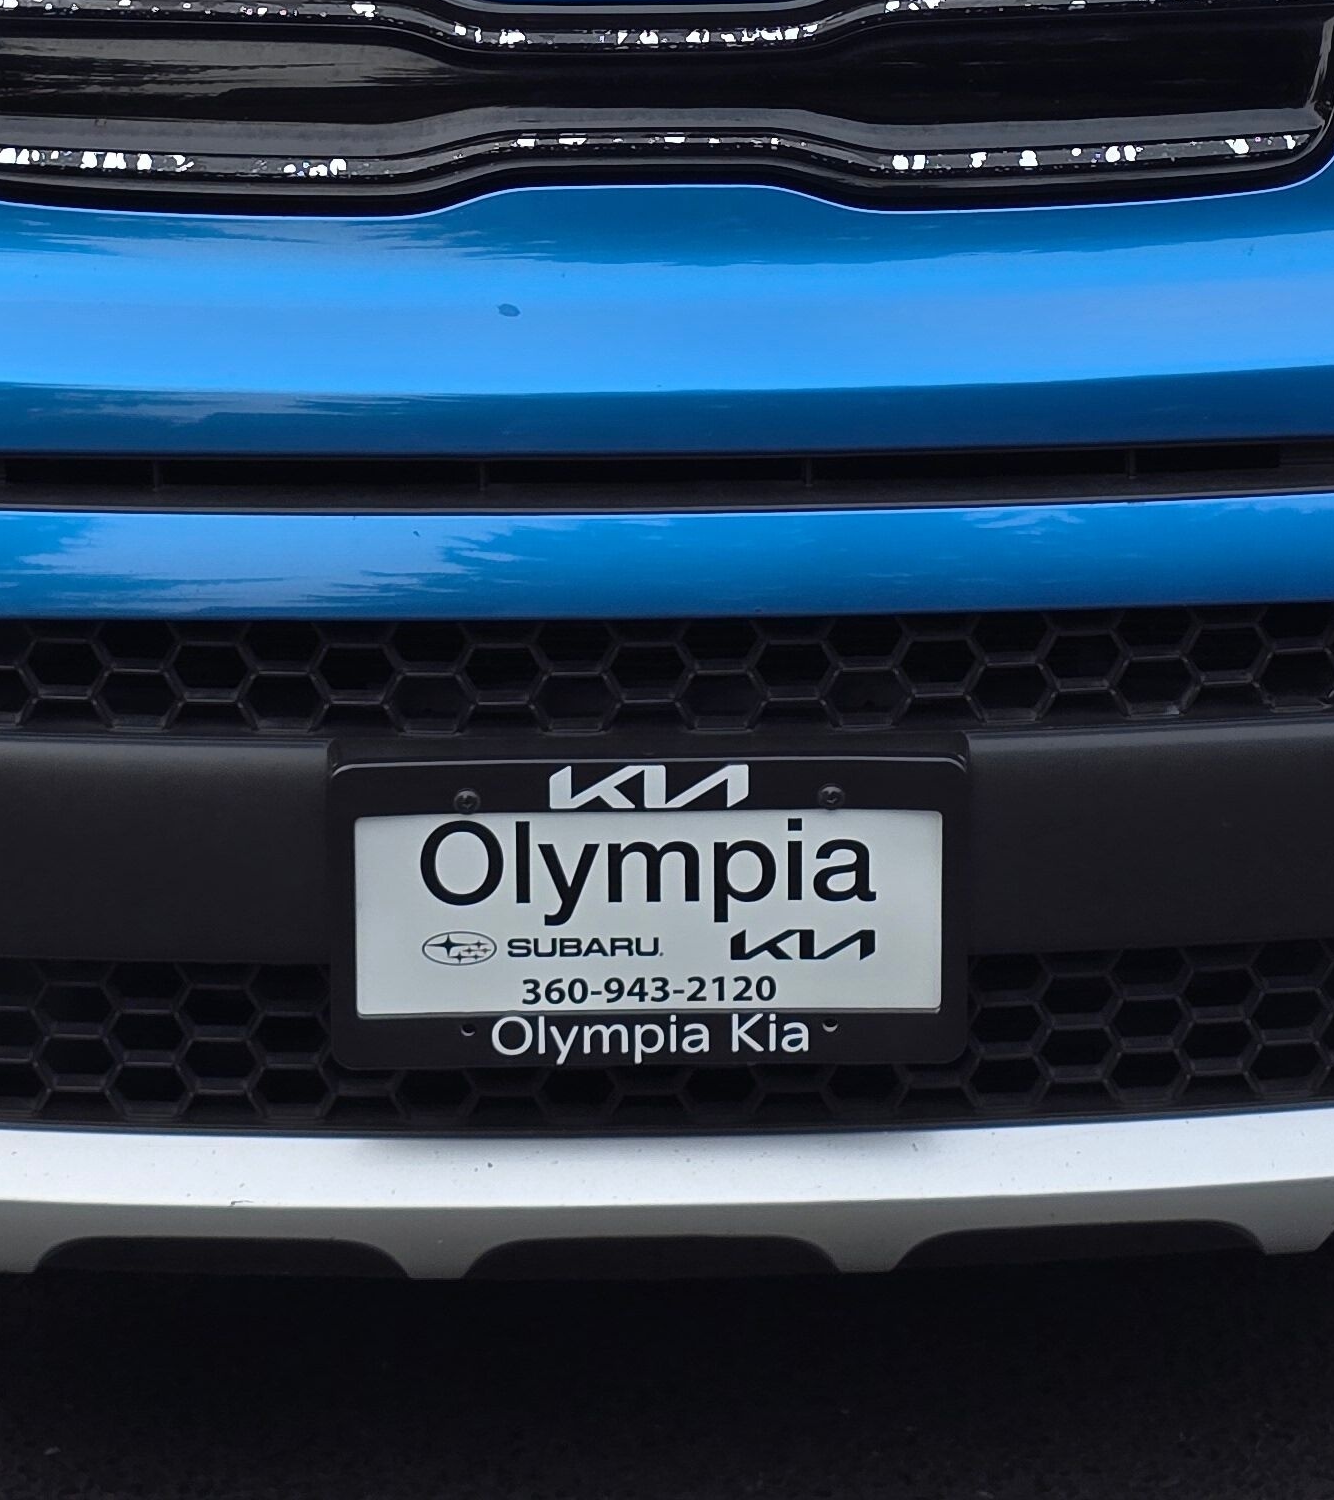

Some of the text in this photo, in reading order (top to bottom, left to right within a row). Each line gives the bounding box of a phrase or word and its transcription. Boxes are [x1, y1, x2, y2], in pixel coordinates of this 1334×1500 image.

[549, 764, 749, 809] KIA
[420, 817, 877, 926] Olympia
[507, 936, 660, 958] SUBARU
[521, 975, 777, 1005] 360-943-2120
[491, 1012, 810, 1065] Olympia Kia
